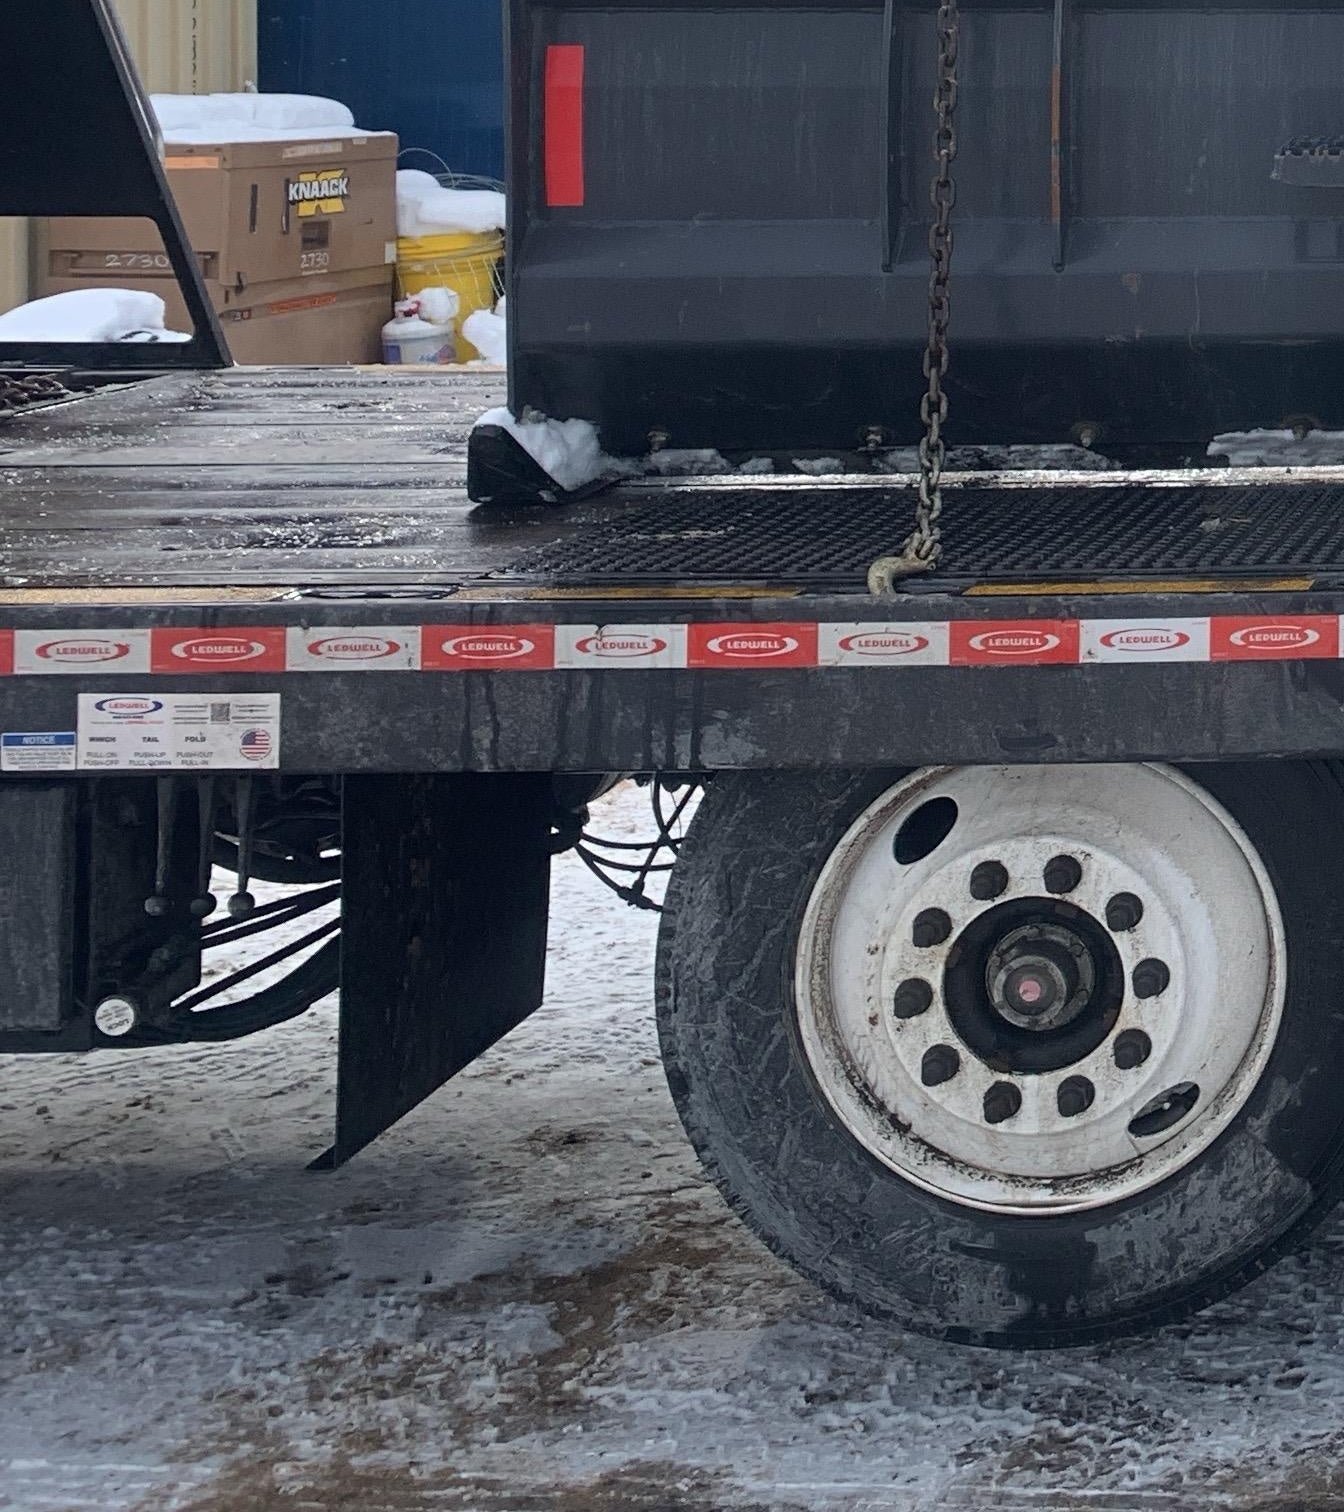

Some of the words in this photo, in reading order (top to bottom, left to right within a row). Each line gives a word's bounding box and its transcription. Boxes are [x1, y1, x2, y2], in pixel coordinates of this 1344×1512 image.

[288, 177, 349, 202] KNAACK
[105, 254, 169, 268] 2730
[300, 252, 329, 268] 2730
[988, 637, 1042, 647] LEDWELL
[1119, 635, 1172, 644] LEDWELL
[1249, 632, 1302, 643] LEDWELL
[327, 643, 382, 653] LEDWELL
[461, 642, 516, 652] LEDWELL
[595, 640, 649, 650] LEDWELL
[727, 639, 780, 649] LEDWELL
[858, 638, 911, 648] LEDWELL
[192, 644, 247, 654] LEDWELL
